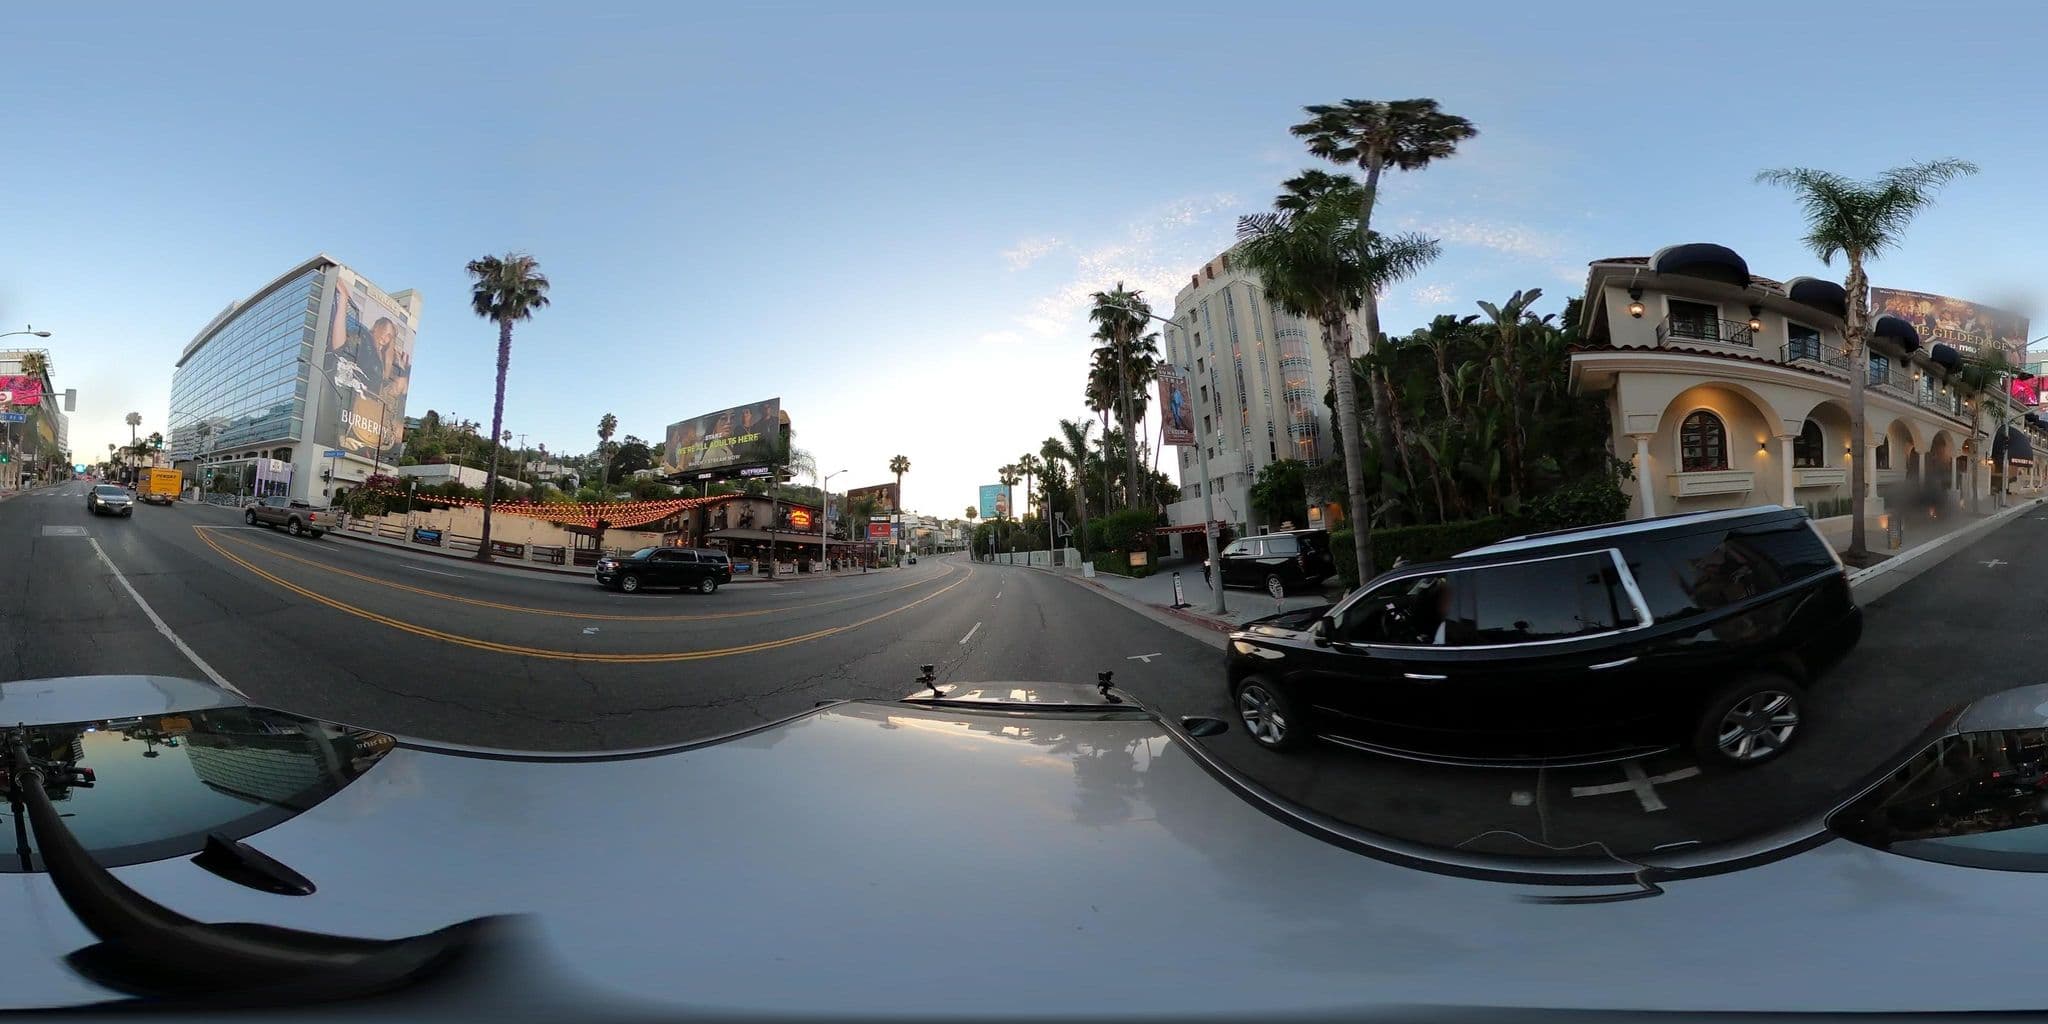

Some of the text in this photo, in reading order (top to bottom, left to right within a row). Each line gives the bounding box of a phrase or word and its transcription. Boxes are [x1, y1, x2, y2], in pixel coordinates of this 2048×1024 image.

[1933, 325, 1984, 345] GILDED
[1985, 335, 2010, 352] AGE
[709, 437, 736, 449] ADULTS
[738, 432, 760, 444] HERE
